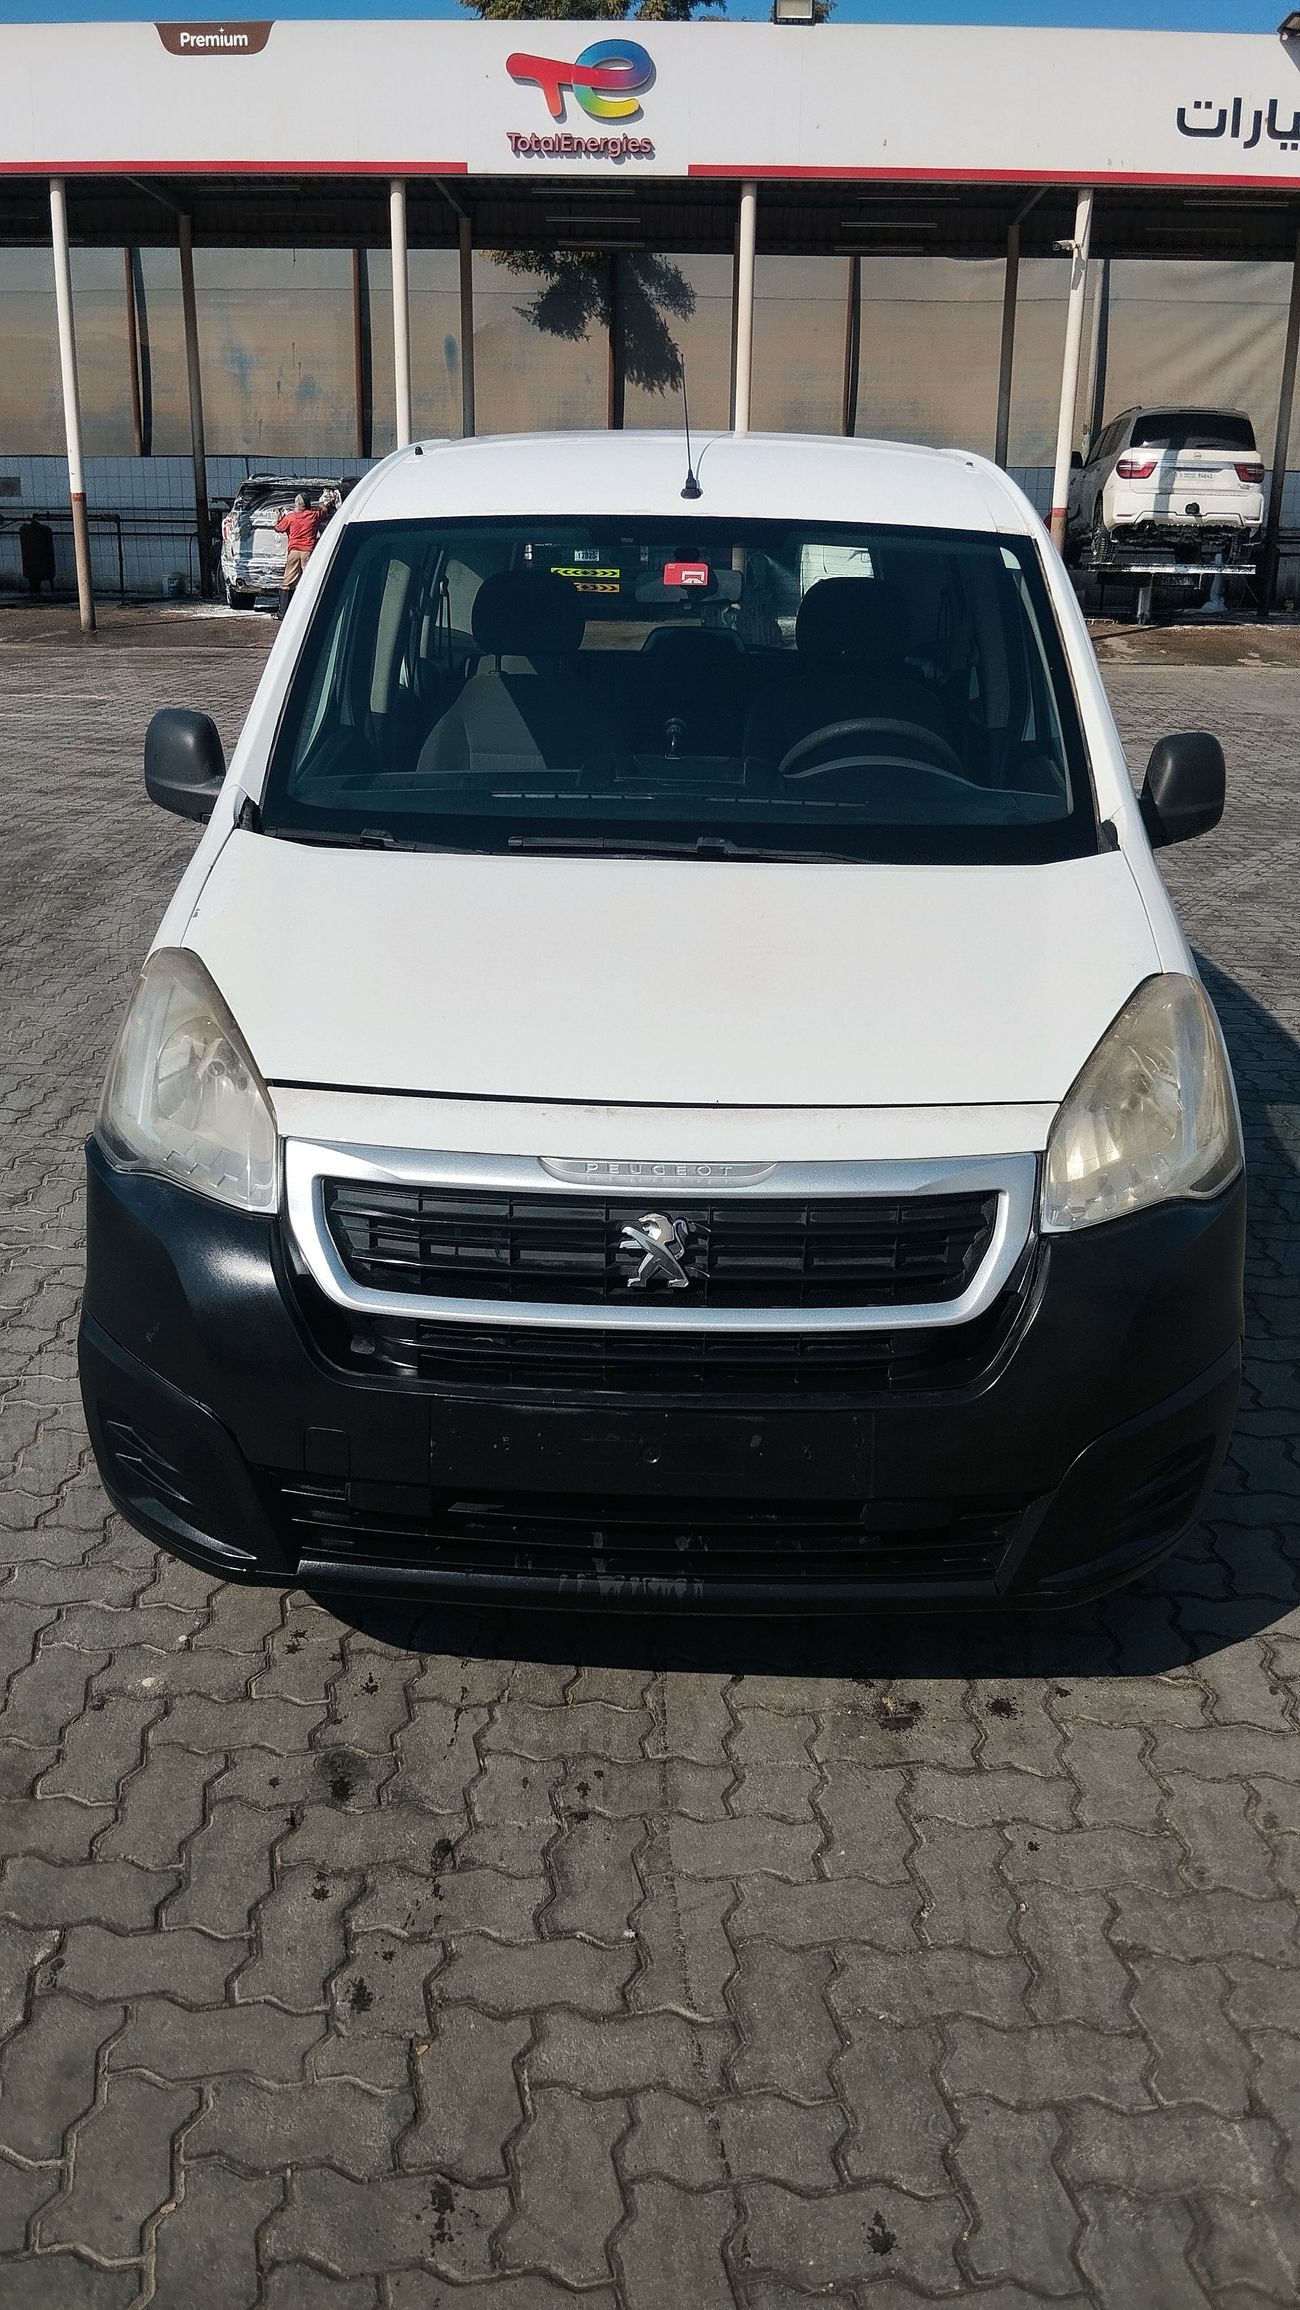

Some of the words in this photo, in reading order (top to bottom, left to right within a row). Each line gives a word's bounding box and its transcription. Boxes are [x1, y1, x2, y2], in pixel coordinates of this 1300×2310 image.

[180, 28, 248, 47] Premium
[507, 133, 653, 157] TotalEnergies
[585, 1162, 733, 1176] PEUGEOT
